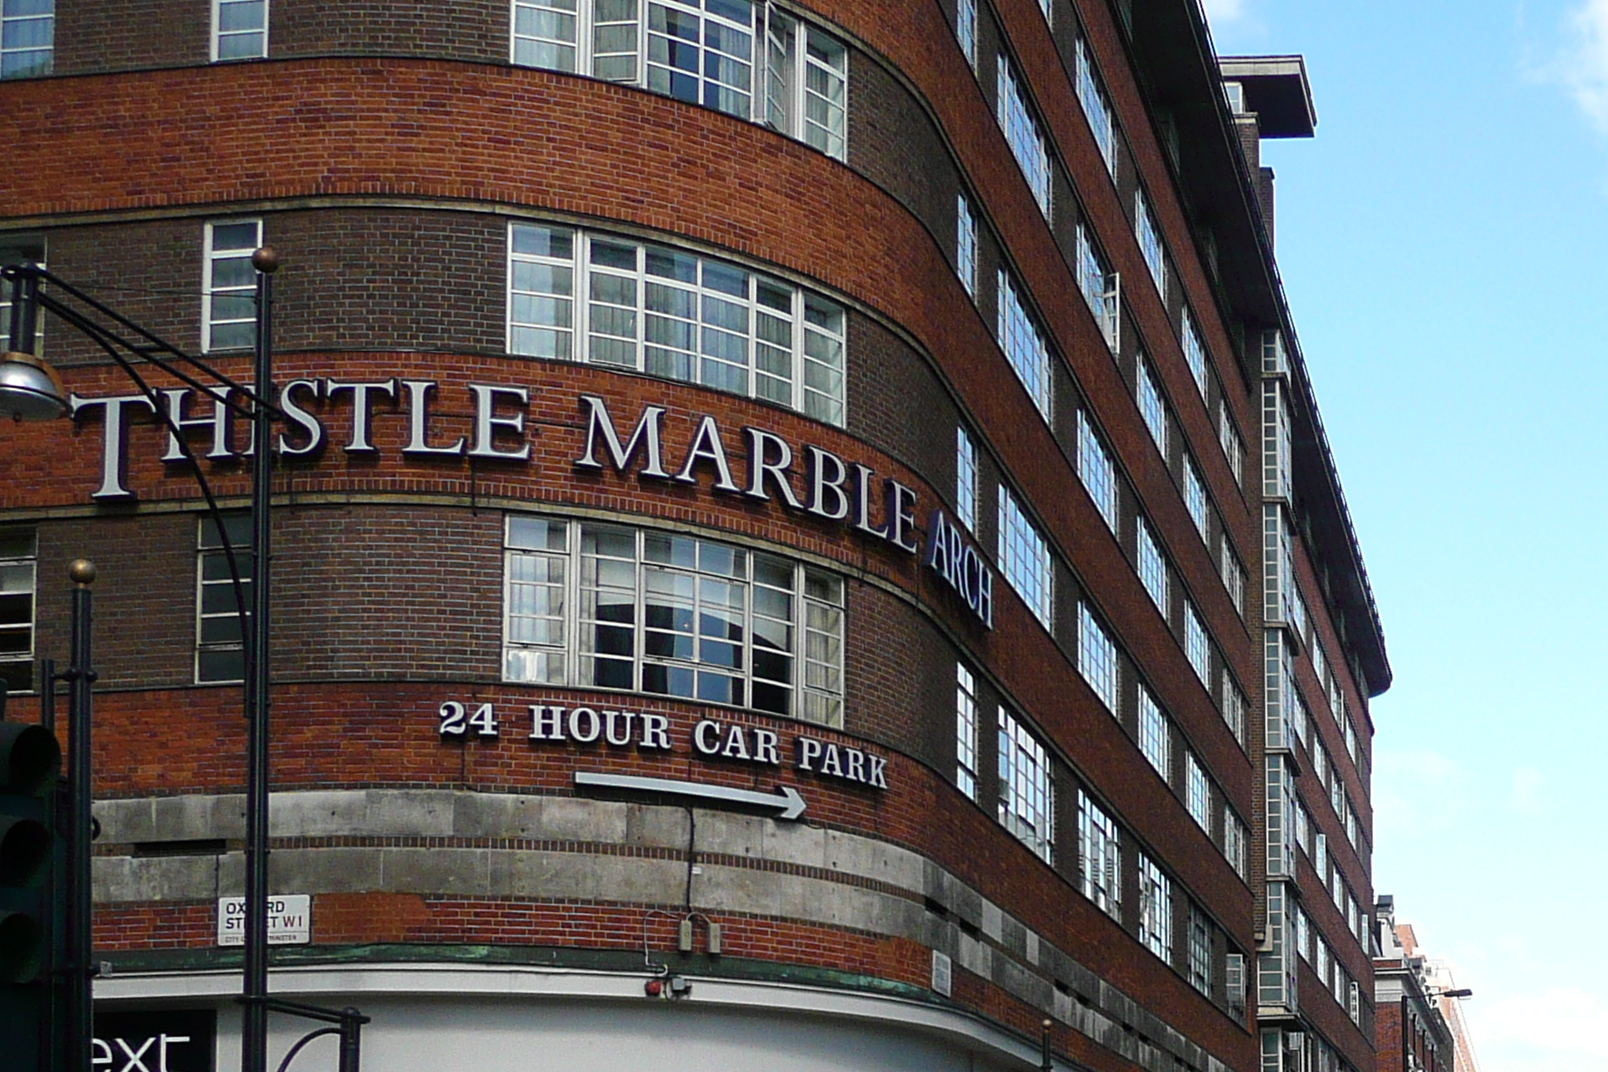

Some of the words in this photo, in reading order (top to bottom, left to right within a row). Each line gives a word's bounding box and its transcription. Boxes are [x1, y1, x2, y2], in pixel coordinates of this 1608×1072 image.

[572, 395, 918, 555] MARBLE
[928, 509, 994, 631] ARCH
[439, 701, 498, 736] 24
[528, 704, 672, 750] HOUR
[694, 720, 782, 765] CAR
[797, 737, 890, 790] PARK
[225, 916, 279, 929] STT
[226, 901, 285, 915] OXRD
